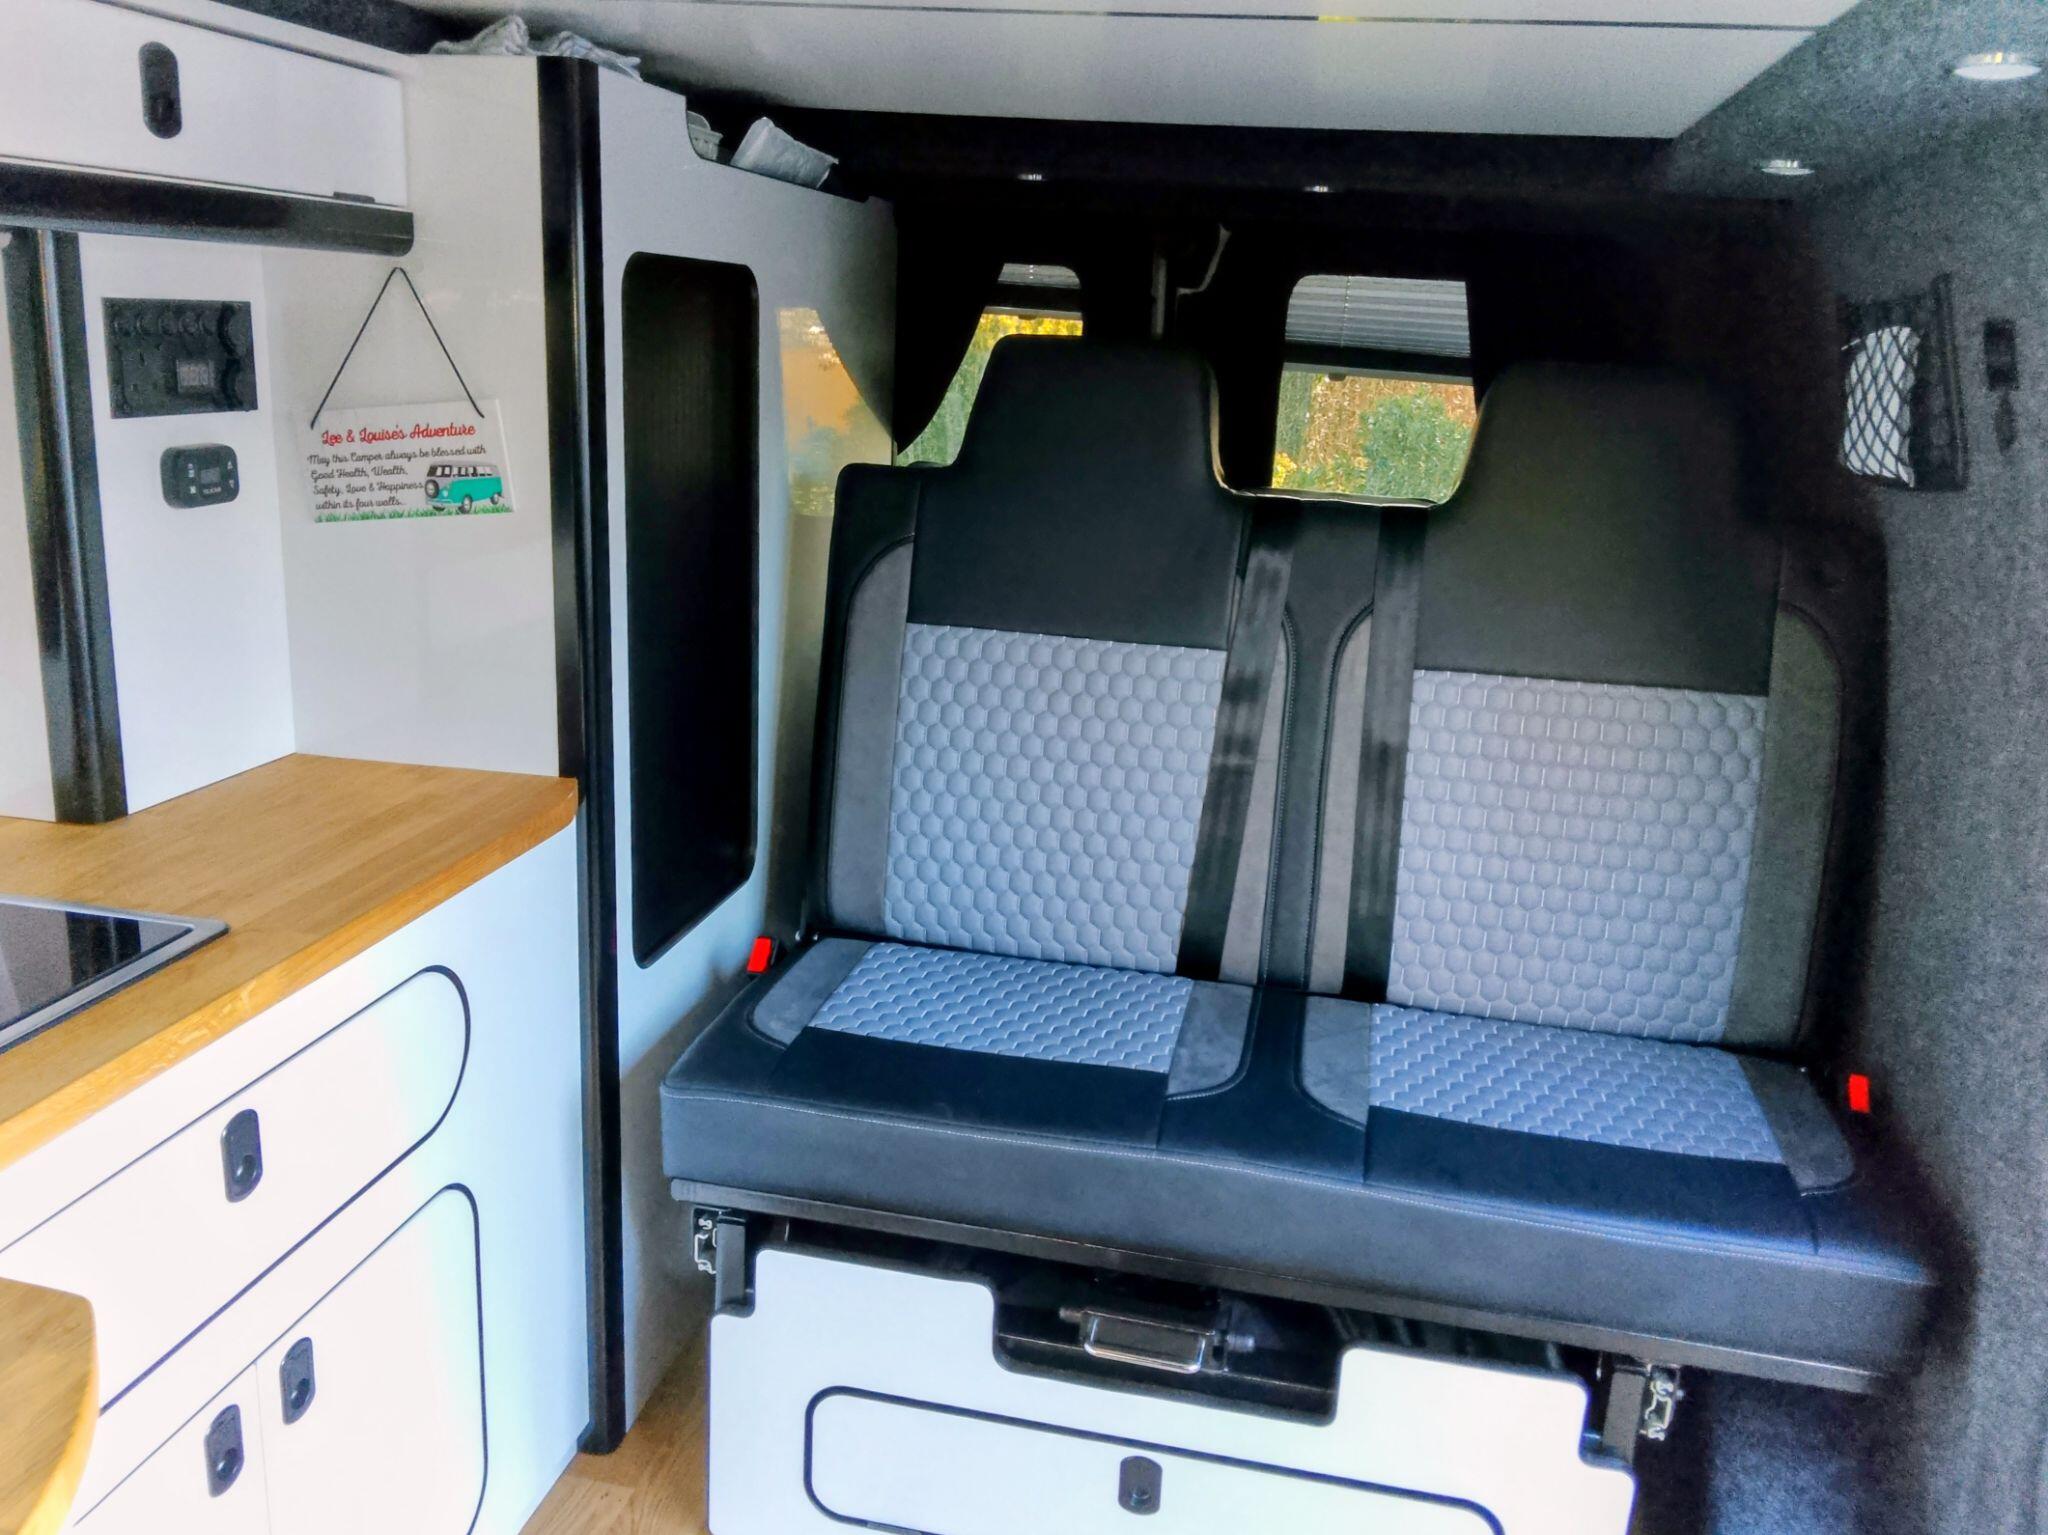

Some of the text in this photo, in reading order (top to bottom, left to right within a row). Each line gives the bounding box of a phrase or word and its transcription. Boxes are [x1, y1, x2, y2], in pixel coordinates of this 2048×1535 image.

[321, 422, 476, 446] Lee & Louise's Adventure
[307, 444, 486, 467] May this Camper always be blessed with
[310, 469, 334, 483] Good
[345, 484, 367, 494] Love
[369, 484, 374, 492] &
[376, 481, 424, 494] Happiness
[315, 500, 341, 510] within
[343, 499, 353, 509] its
[355, 498, 374, 511] four
